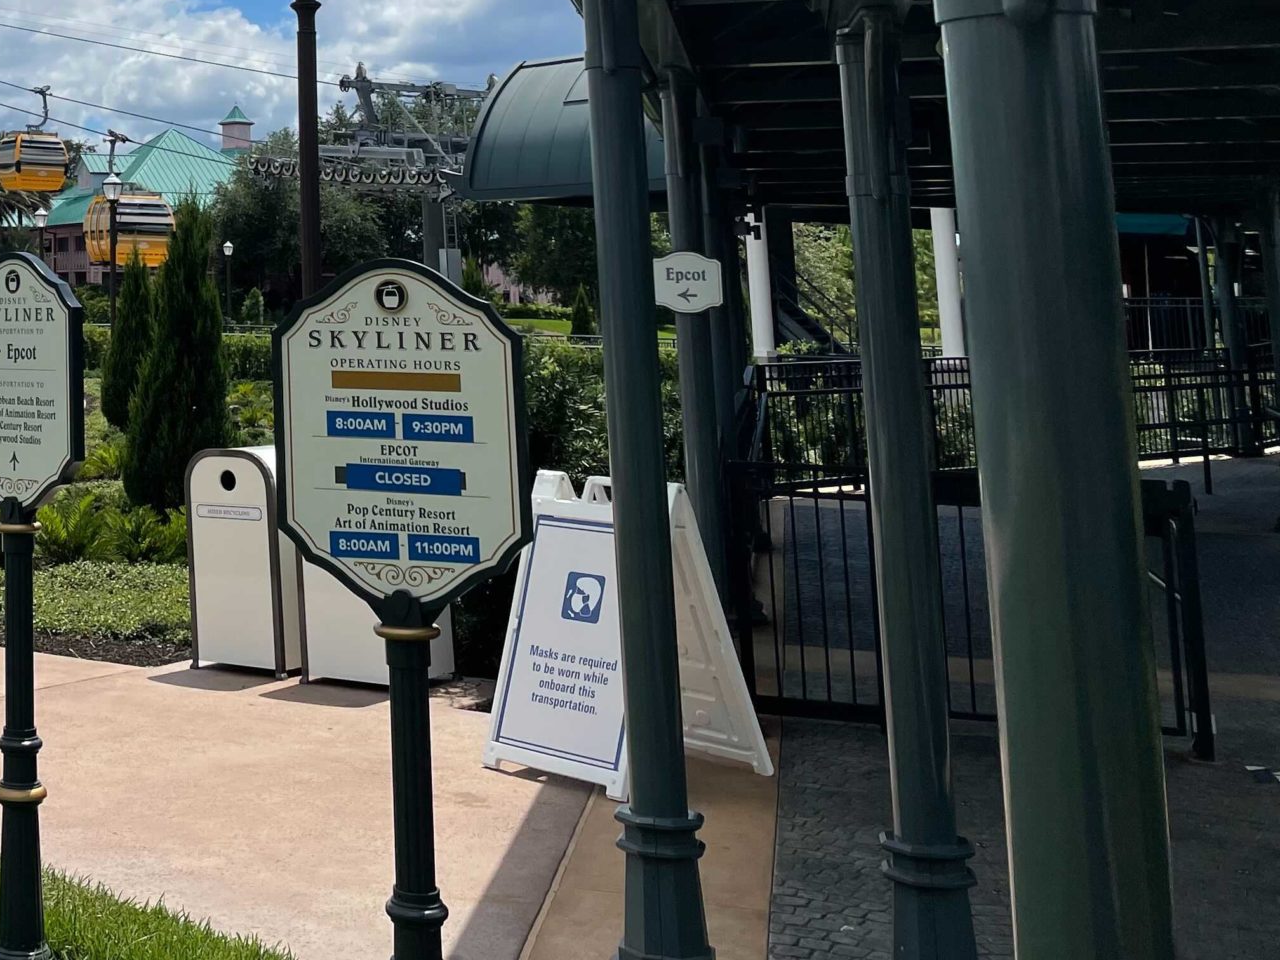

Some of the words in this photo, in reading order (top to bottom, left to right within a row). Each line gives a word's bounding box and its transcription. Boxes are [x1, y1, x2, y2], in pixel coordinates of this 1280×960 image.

[665, 267, 707, 283] Epcot
[0, 297, 26, 305] DISNEY
[364, 316, 422, 327] DISNEY
[308, 329, 482, 352] SKYLINER
[7, 343, 37, 363] Epcot
[330, 358, 407, 370] OPERATING
[413, 360, 461, 371] HOURS
[36, 381, 45, 389] TO
[16, 396, 34, 406] Beach
[35, 396, 55, 407] Resort
[352, 395, 418, 411] Hollywood
[421, 398, 469, 412] Studios
[5, 408, 36, 419] Animation
[36, 410, 56, 420] Resort
[0, 421, 22, 432] Century
[23, 422, 42, 432] Resort
[335, 418, 387, 431] 8:00AM
[412, 421, 464, 435] 9:30PM
[380, 444, 418, 457] EPCOT
[360, 456, 407, 465] International
[409, 458, 439, 468] Gateway
[375, 471, 431, 486] CLOSED
[386, 497, 414, 506] Disney's
[347, 503, 369, 518] Pop
[372, 505, 415, 520] Century
[419, 507, 456, 521] Resort
[334, 517, 352, 529] Art
[355, 518, 367, 530] of
[370, 519, 429, 533] Animation
[433, 522, 470, 536] Resort
[339, 539, 391, 553] 8:00AM
[414, 542, 473, 557] 11:00PM
[529, 644, 559, 660] Masks
[561, 653, 576, 664] are
[578, 656, 618, 672] required
[532, 662, 541, 672] to
[543, 663, 555, 675] be
[557, 667, 581, 680] worn
[583, 671, 609, 685] while
[539, 679, 576, 695] onboard
[578, 685, 596, 699] this
[531, 692, 597, 715] transportation.
